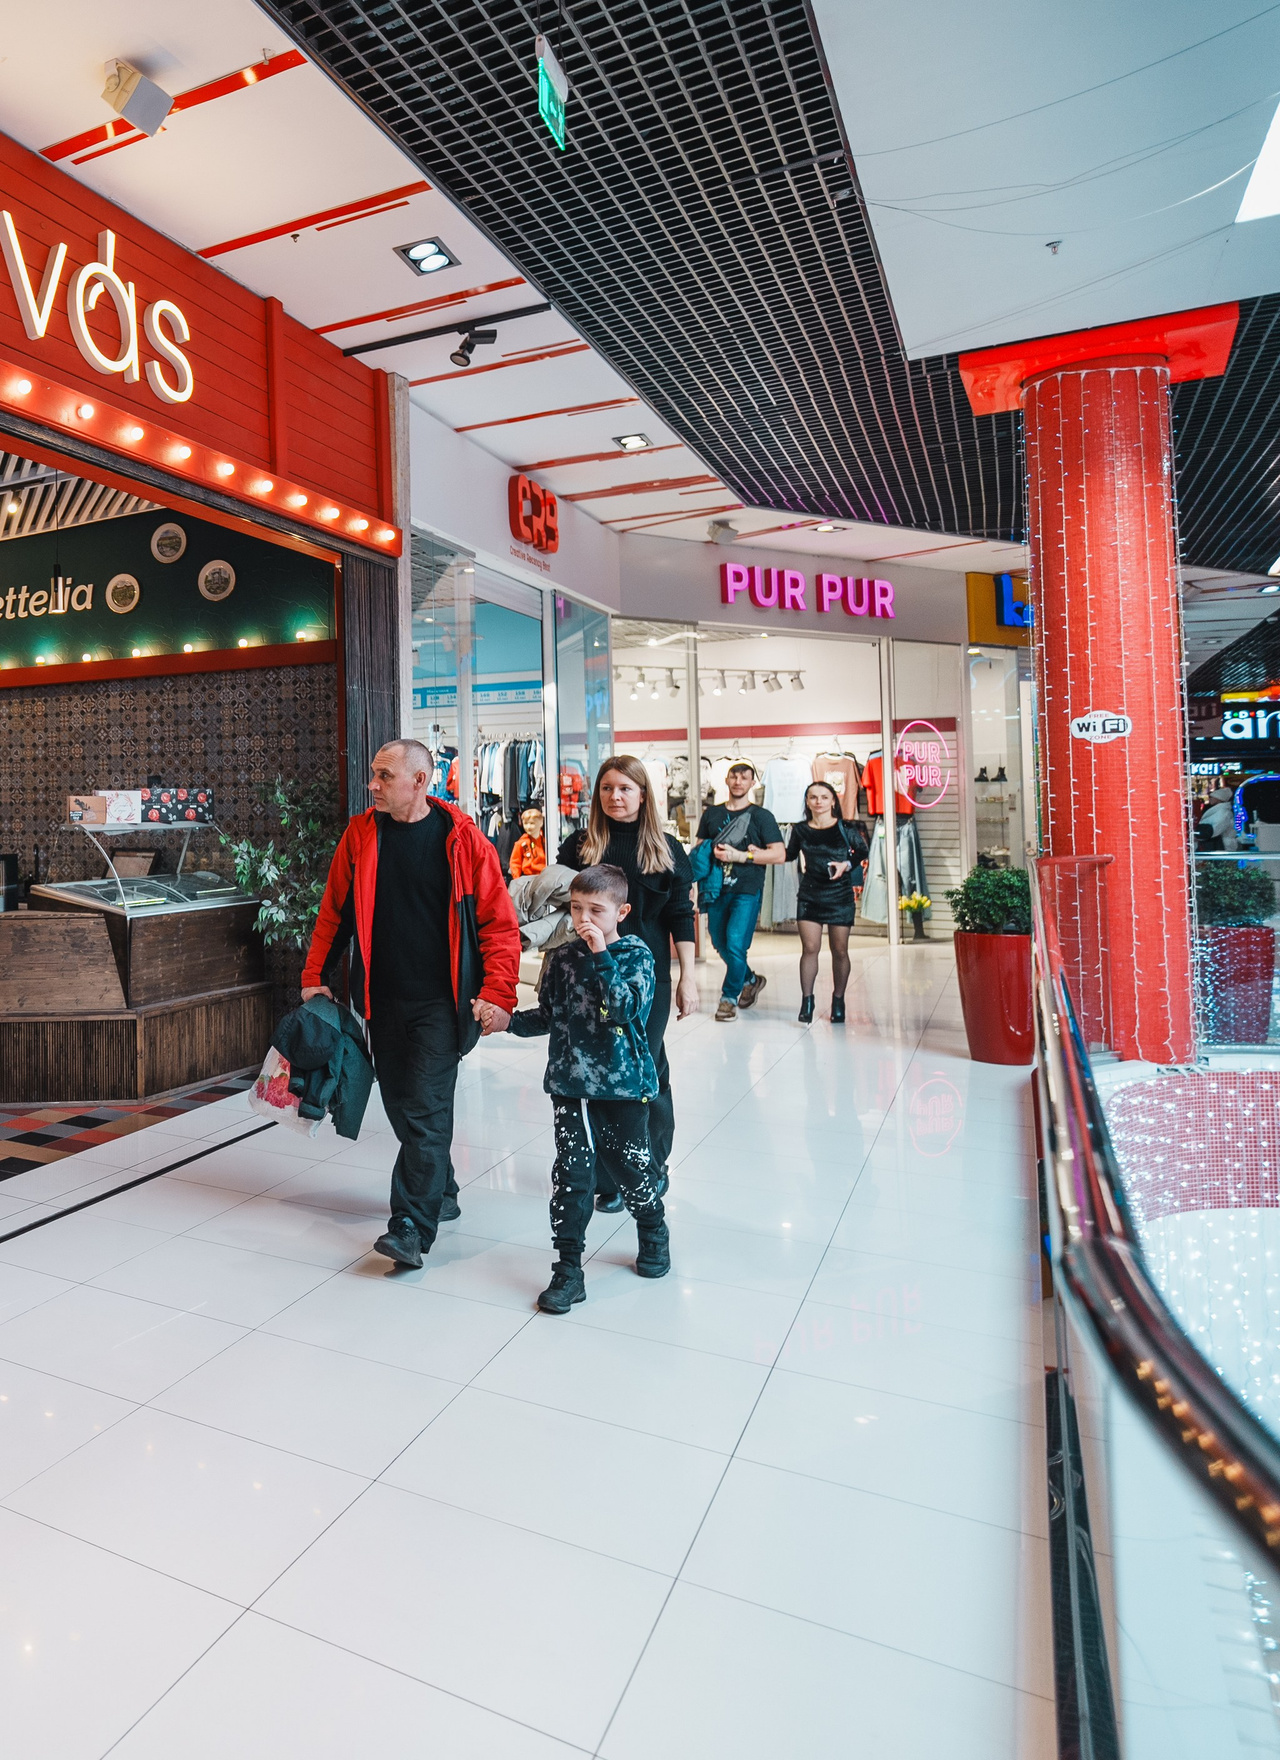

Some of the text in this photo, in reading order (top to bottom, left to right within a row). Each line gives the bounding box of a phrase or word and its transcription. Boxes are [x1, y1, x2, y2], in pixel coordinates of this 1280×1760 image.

[720, 562, 896, 619] PUR PUR
[903, 741, 940, 763] PUR
[904, 765, 942, 787] PUR
